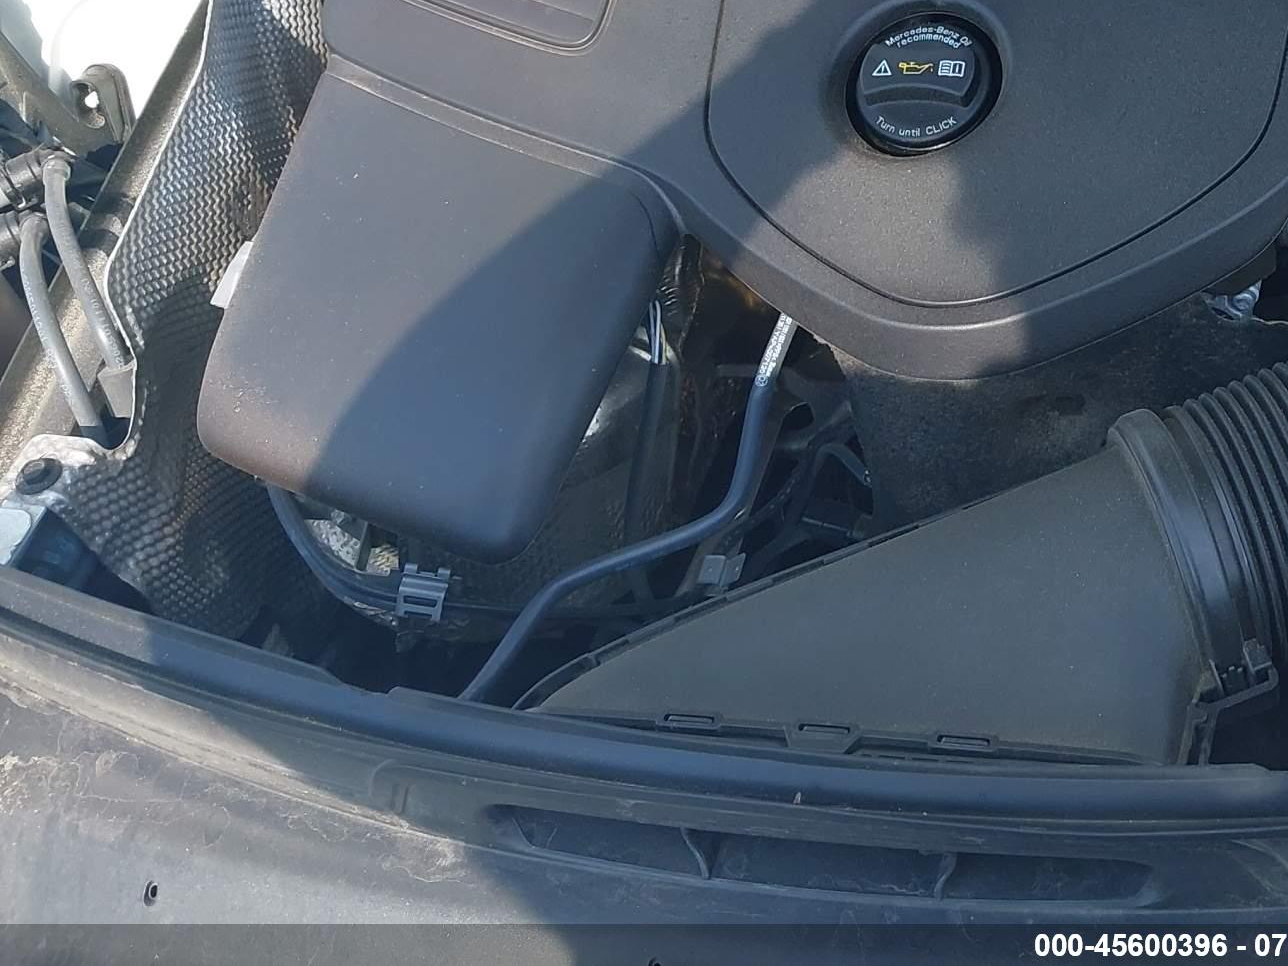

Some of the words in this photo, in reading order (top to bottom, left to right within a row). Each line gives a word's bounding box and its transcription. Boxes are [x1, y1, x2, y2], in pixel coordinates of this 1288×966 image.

[885, 25, 960, 46] Mercedes-Benz
[960, 36, 973, 47] Oil
[897, 33, 961, 49] recommended
[876, 116, 895, 133] Turn
[899, 127, 920, 136] until
[925, 117, 957, 135] CLICK
